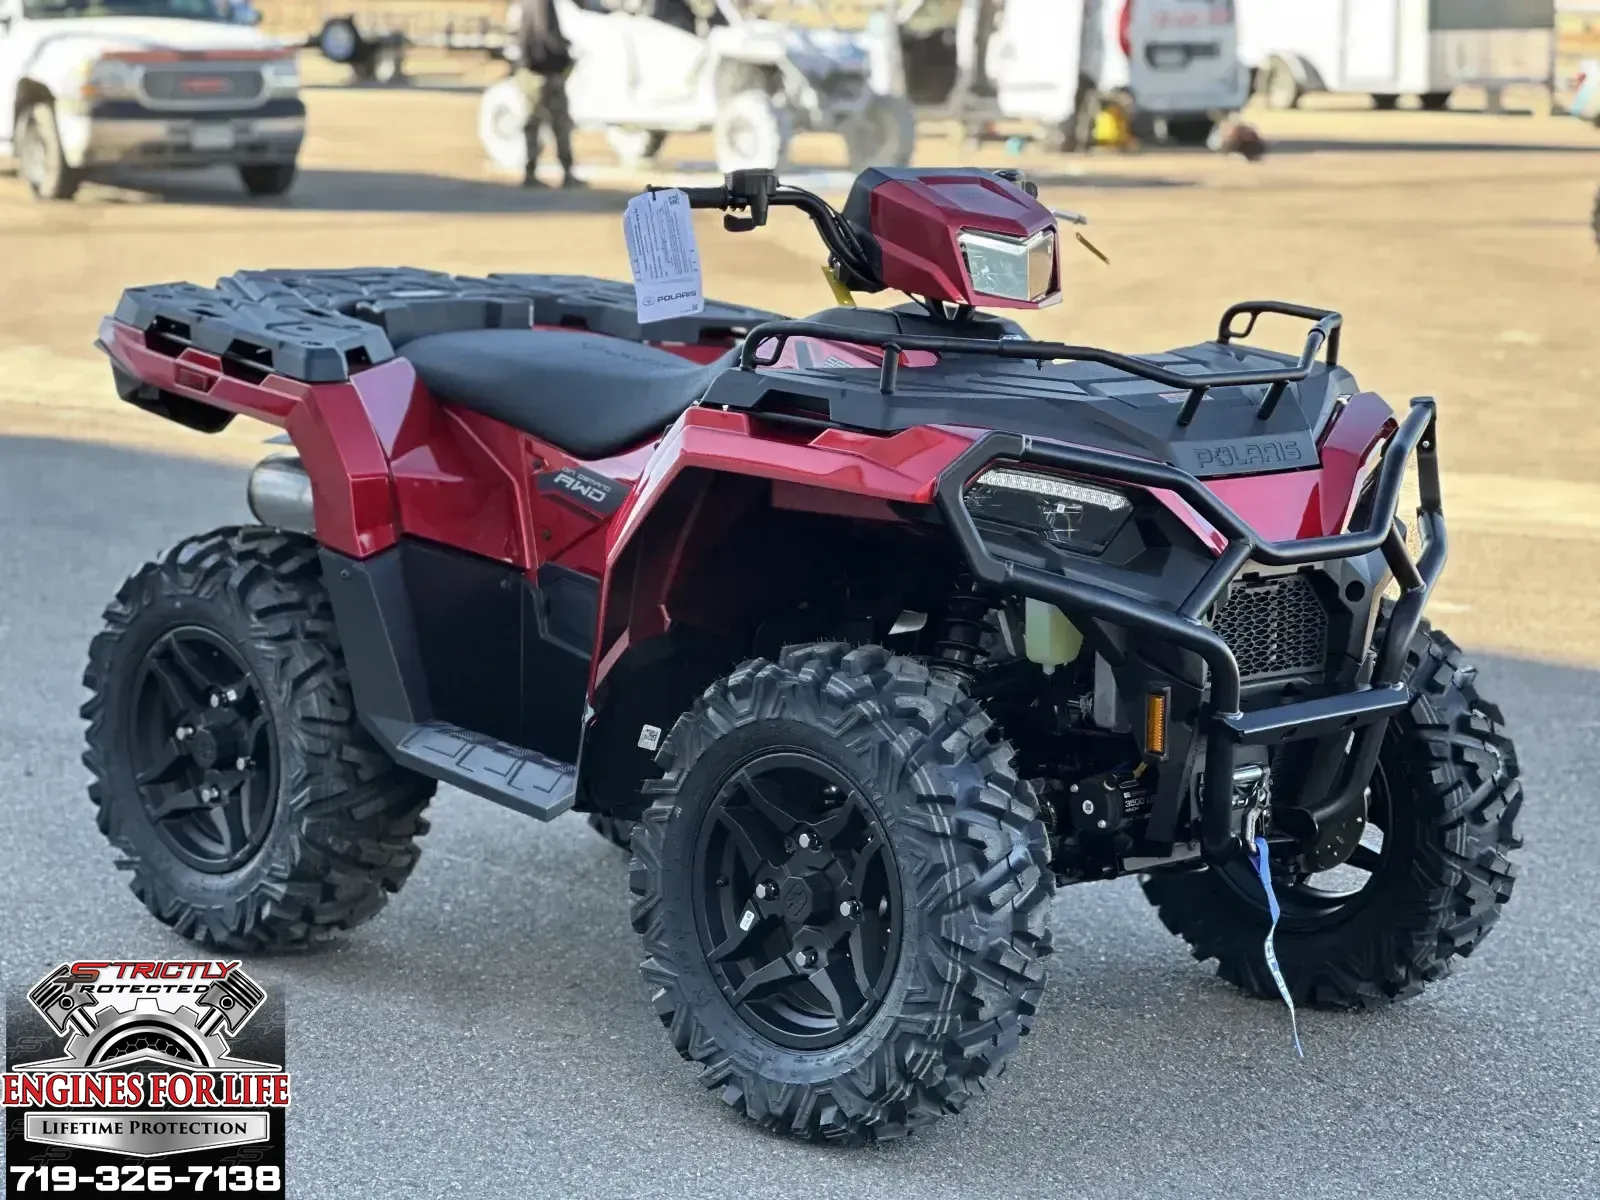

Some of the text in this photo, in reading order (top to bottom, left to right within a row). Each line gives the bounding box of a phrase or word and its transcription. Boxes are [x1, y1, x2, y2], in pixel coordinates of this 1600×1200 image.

[657, 290, 697, 303] POLARIS
[1193, 441, 1302, 469] POLARIS
[553, 473, 607, 503] AWD
[1124, 797, 1145, 808] 3500
